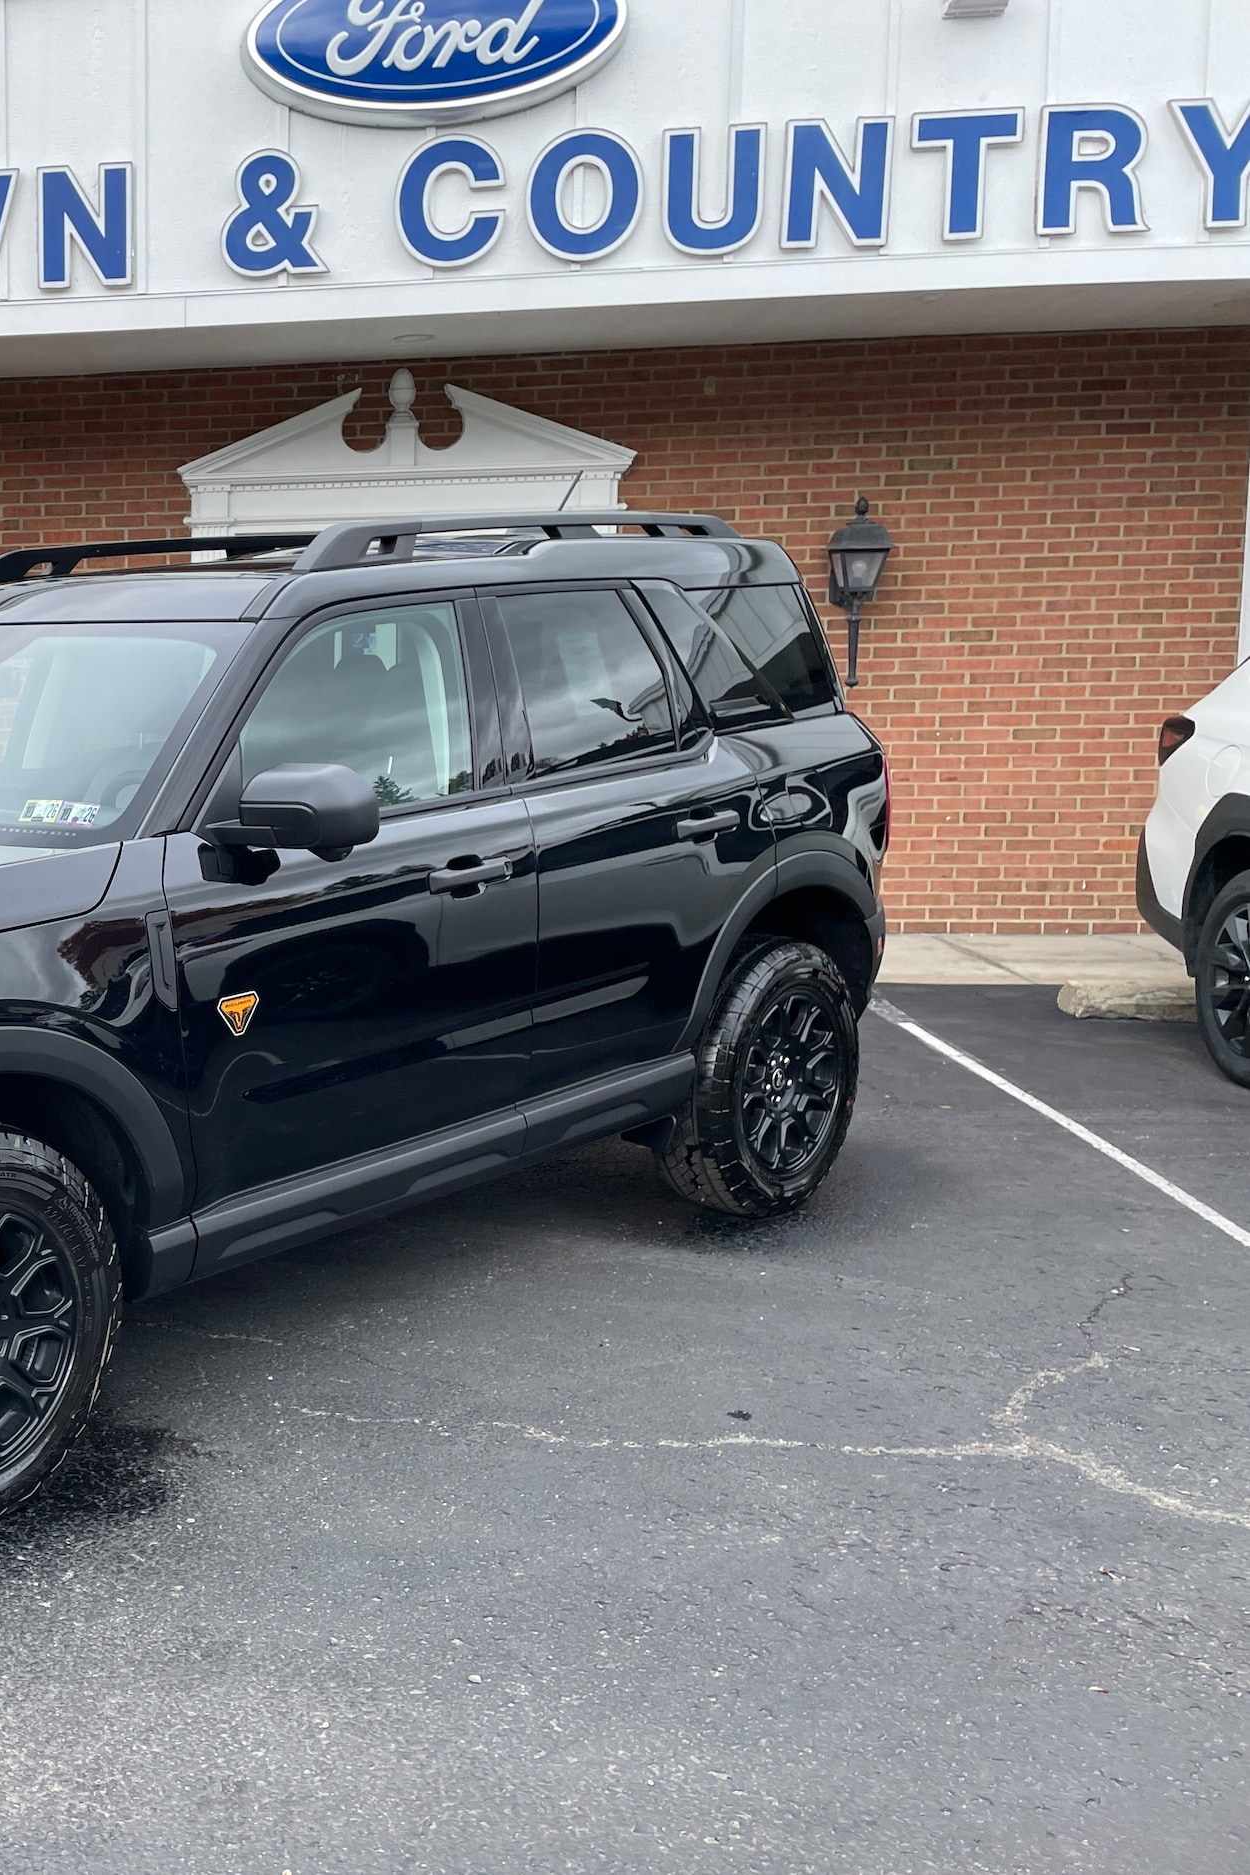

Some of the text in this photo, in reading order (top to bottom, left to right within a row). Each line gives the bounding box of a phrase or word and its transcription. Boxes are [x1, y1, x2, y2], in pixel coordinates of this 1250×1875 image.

[325, 0, 539, 76] Ford
[221, 148, 330, 278] &
[396, 97, 1250, 268] COUNTRY
[46, 803, 60, 819] 26
[83, 806, 98, 823] 26
